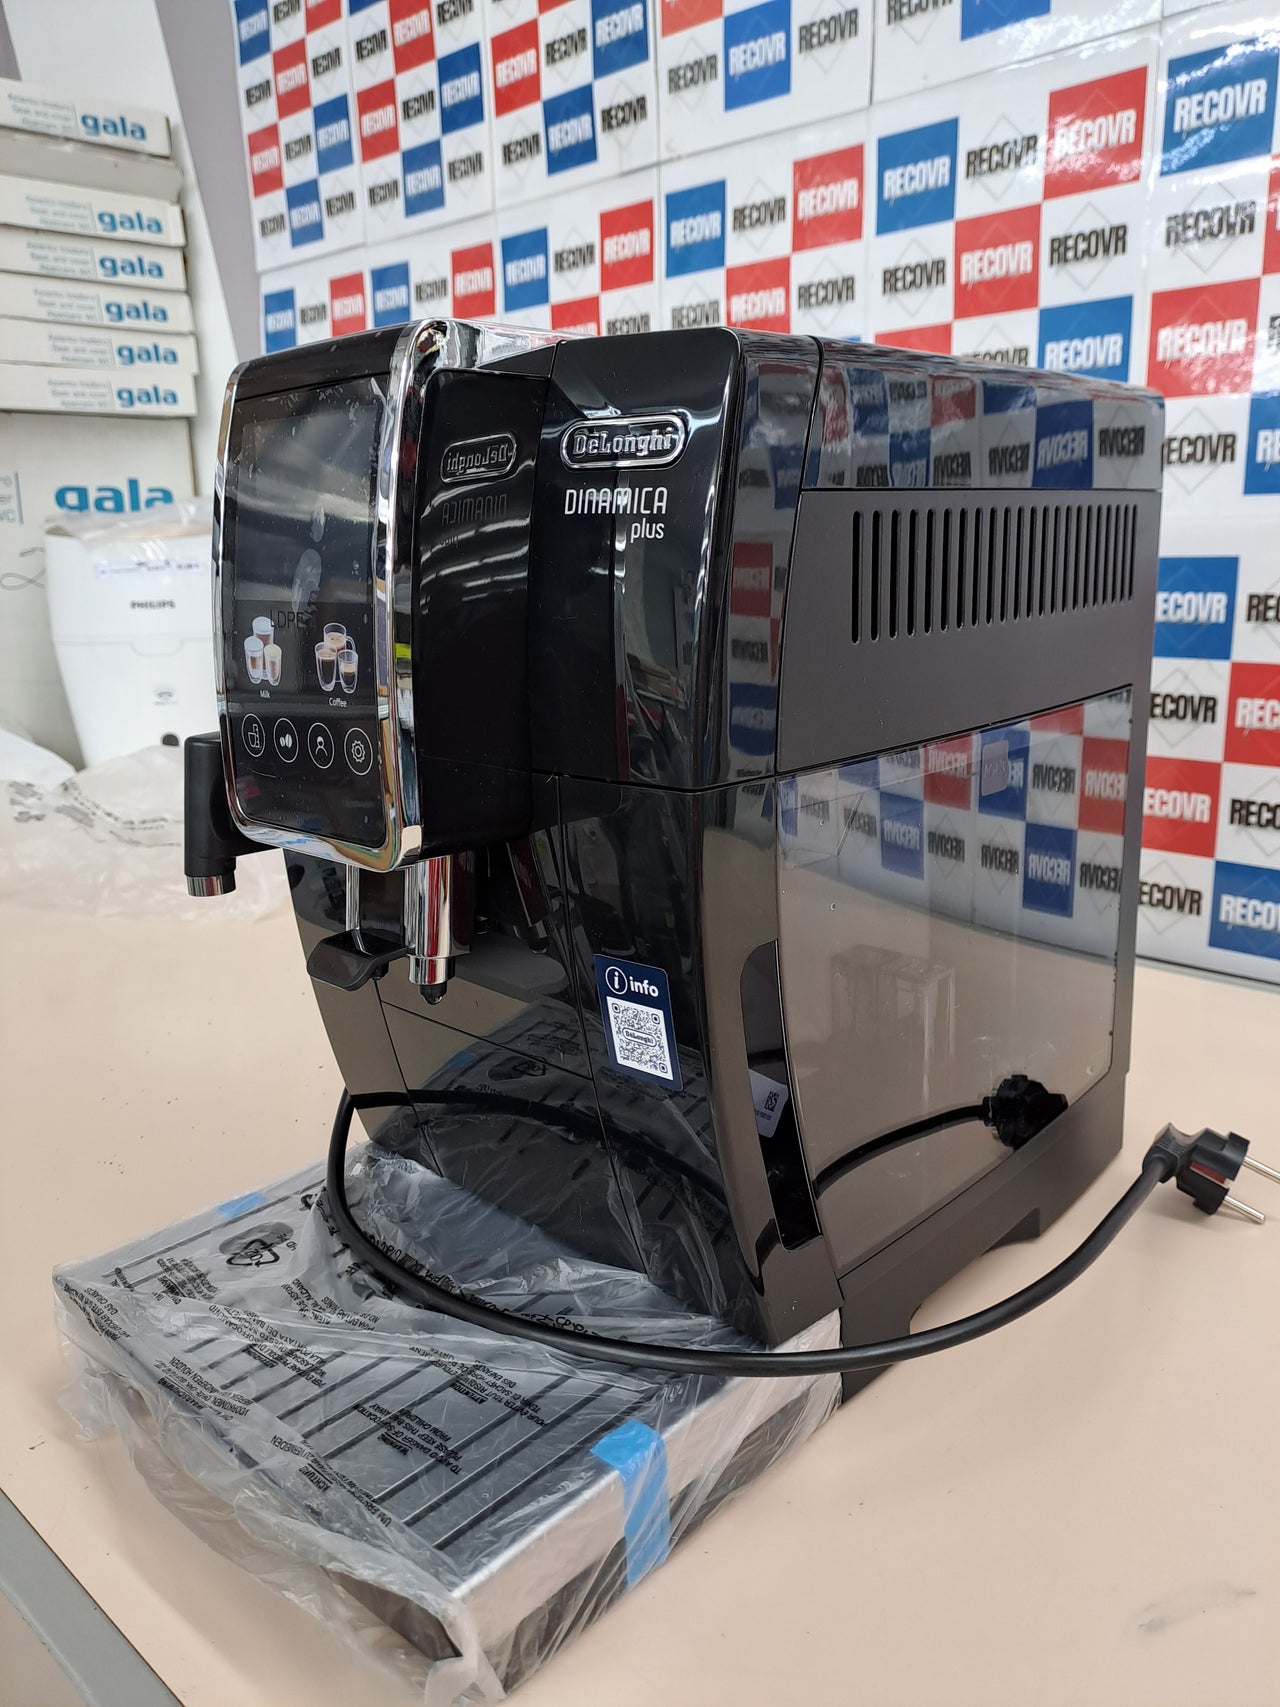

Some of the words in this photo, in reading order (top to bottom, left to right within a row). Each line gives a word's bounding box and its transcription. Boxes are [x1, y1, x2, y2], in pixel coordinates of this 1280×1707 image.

[595, 3, 643, 48] RECOVR
[799, 8, 859, 54] RECOVR
[545, 28, 588, 66] RECOVR
[729, 31, 786, 77] RECOVR
[495, 48, 537, 88] RECOVR
[668, 54, 718, 95] RECOVR
[601, 95, 647, 133] RECOVR
[1172, 79, 1268, 133] RECOVR
[81, 113, 147, 141] gala
[548, 112, 593, 152] RECOVR
[1056, 109, 1137, 155] RECOVR
[502, 133, 541, 166] RECOVR
[966, 134, 1038, 179] RECOVR
[884, 155, 950, 200] RECOVR
[733, 197, 786, 232] RECOVR
[798, 178, 859, 220] RECOVR
[98, 211, 163, 235] gala
[670, 211, 722, 248] RECOVR
[1165, 200, 1256, 248] RECOVR
[554, 242, 595, 273] RECOVR
[603, 228, 651, 264] RECOVR
[960, 240, 1034, 283] RECOVR
[1050, 224, 1127, 268] RECOVR
[99, 255, 165, 279] gala
[505, 254, 546, 286] RECOVR
[883, 259, 946, 295] RECOVR
[731, 287, 785, 322] RECOVR
[798, 276, 856, 310] RECOVR
[105, 300, 169, 323] gala
[117, 343, 179, 366] gala
[1157, 319, 1249, 362] RECOVR
[116, 385, 179, 408] gala
[1165, 433, 1236, 465] ECOVR
[564, 487, 668, 515] DINAMICA
[630, 518, 665, 544] plus
[1155, 591, 1228, 624] ECOVR
[259, 690, 271, 699] Milk
[329, 697, 347, 708] Coffee
[1150, 693, 1217, 723] ECOVR
[1143, 788, 1211, 823] ECOVR
[1139, 881, 1202, 916] ECOVR
[629, 976, 659, 998] info
[391, 1427, 404, 1438] OF
[401, 1433, 431, 1456] DANGER
[402, 1421, 419, 1435] THIS
[416, 1430, 436, 1446] KEEP
[428, 1425, 451, 1443] FROM
[449, 1463, 462, 1474] TO
